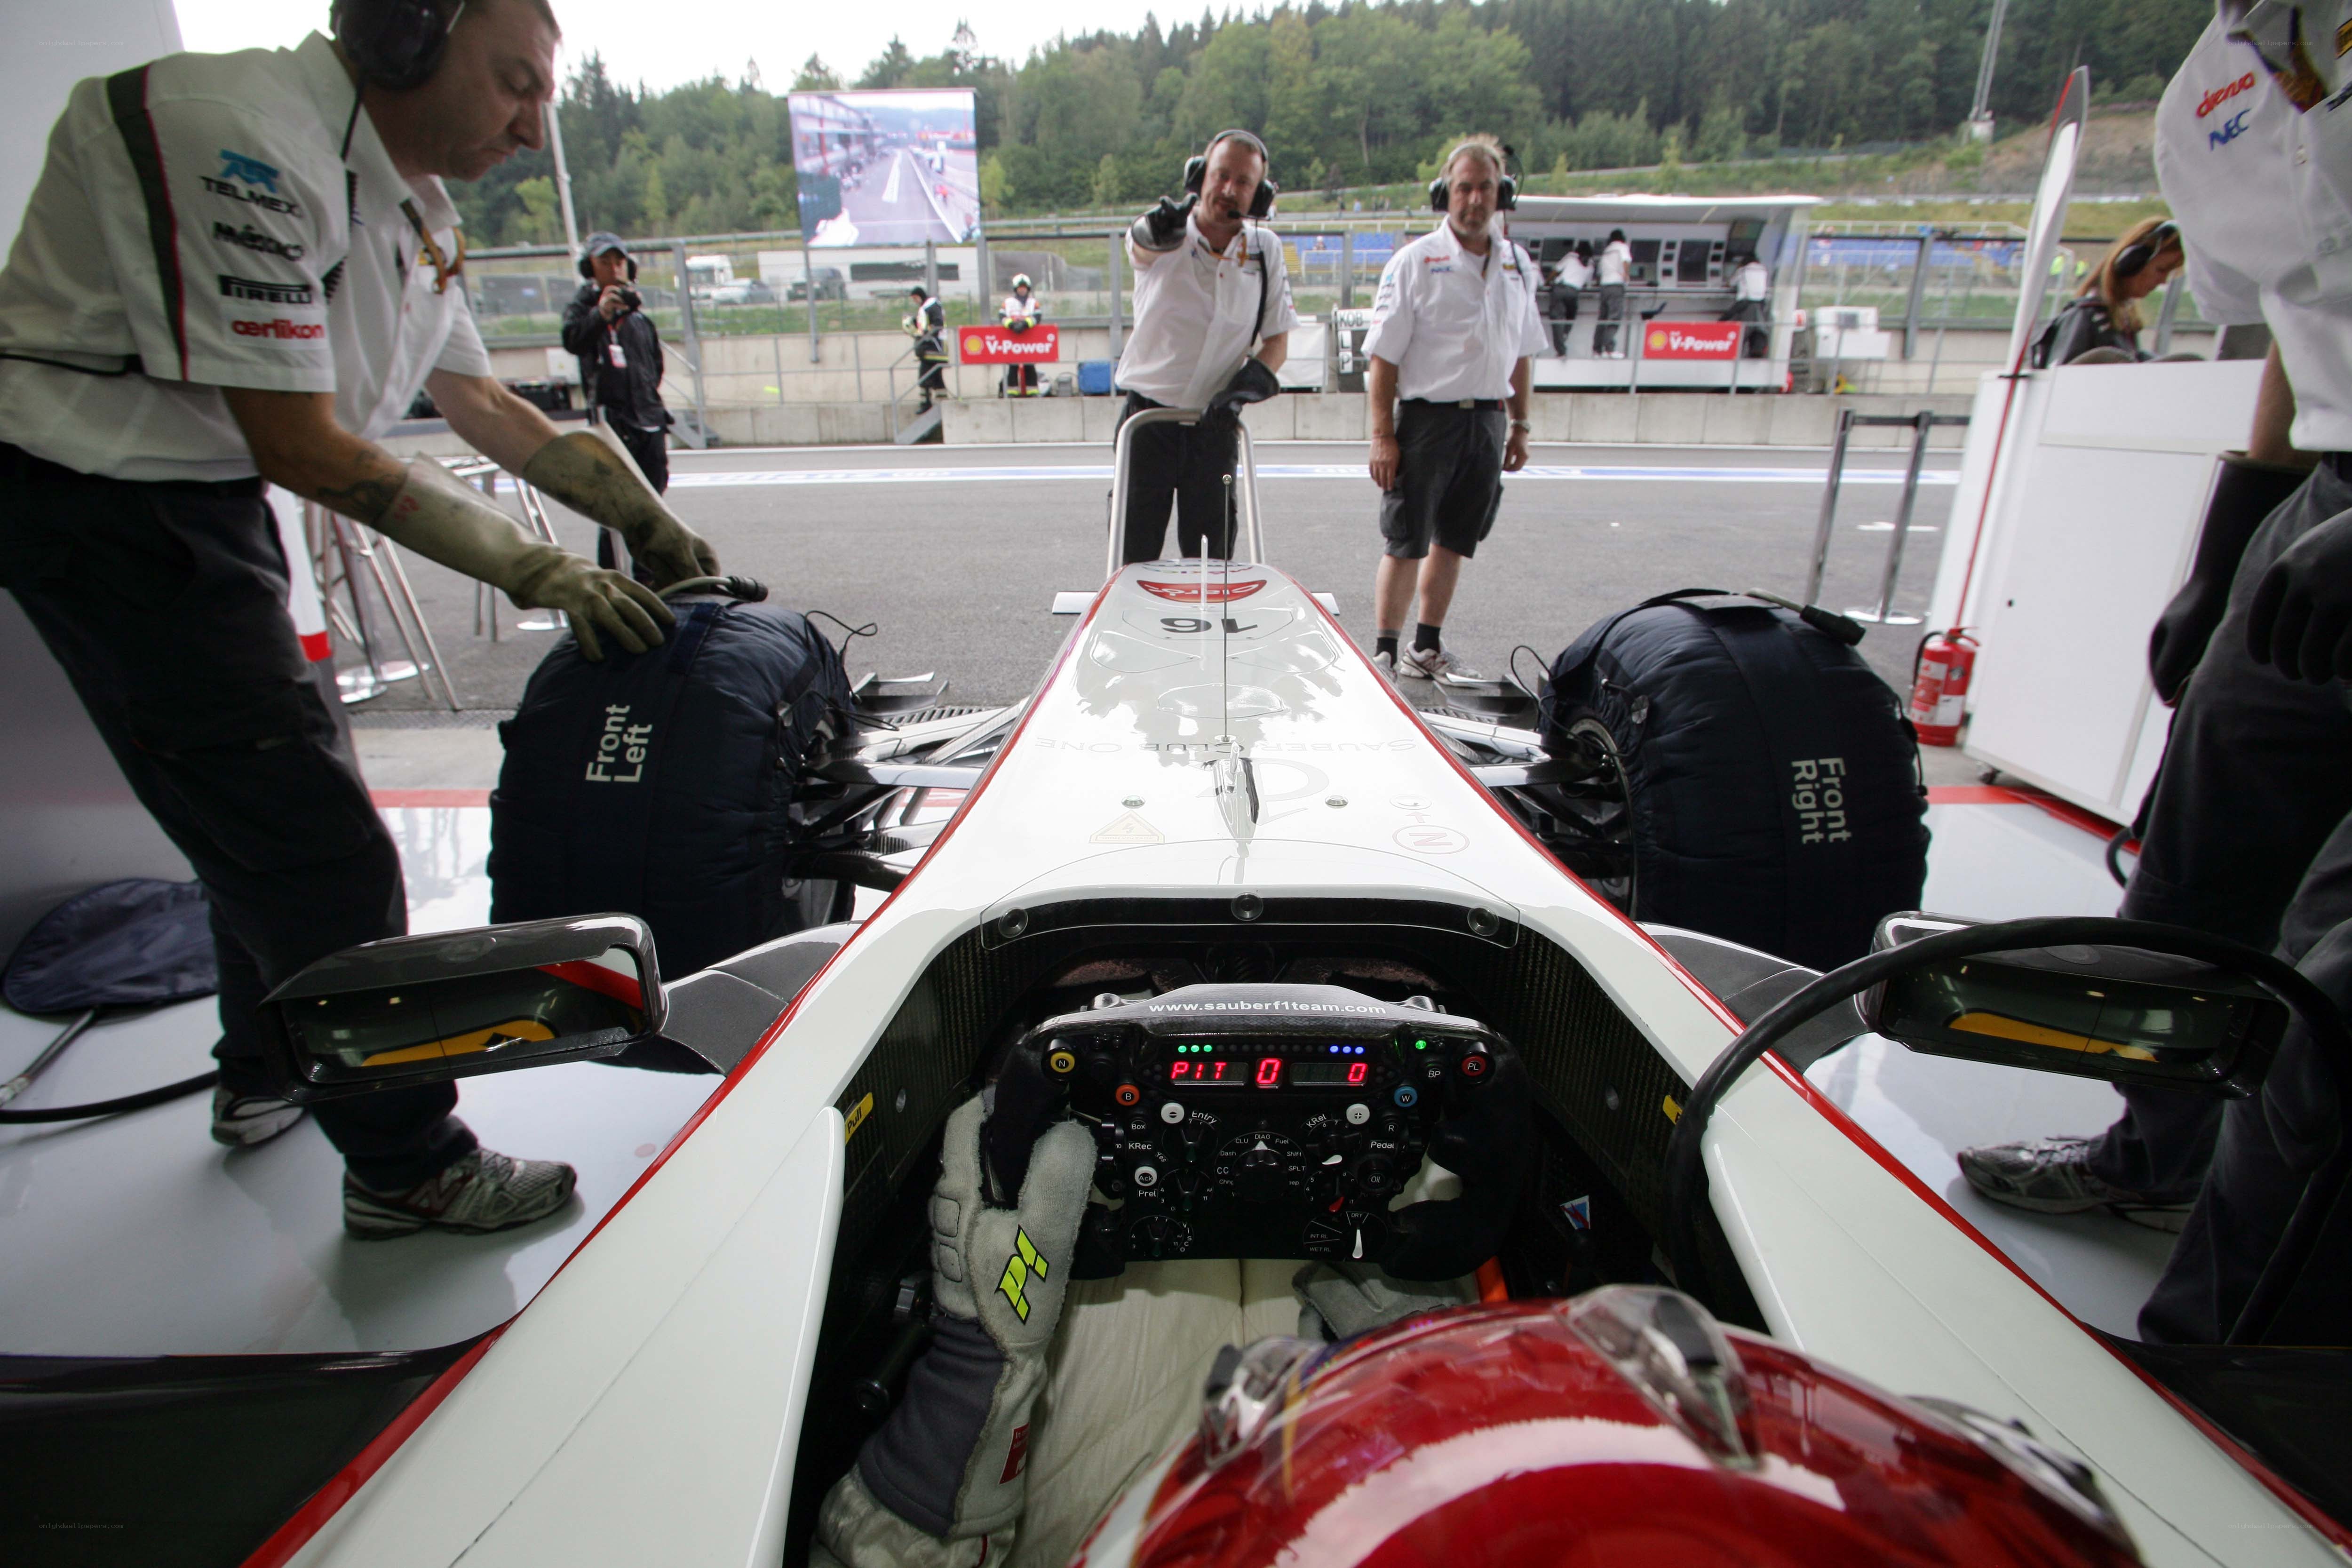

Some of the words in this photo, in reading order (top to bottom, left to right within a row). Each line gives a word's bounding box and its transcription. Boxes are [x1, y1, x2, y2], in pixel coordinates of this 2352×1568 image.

[2209, 108, 2251, 151] NEC
[200, 176, 303, 218] TELMEX
[218, 274, 313, 304] PIRELLI
[1340, 311, 1364, 327] KOB
[985, 340, 1054, 355] V-Power
[1669, 336, 1733, 351] V-Power
[1160, 618, 1258, 634] 16
[586, 703, 630, 782] Front
[1034, 737, 1123, 753] ONE
[613, 724, 653, 783] Left
[1791, 759, 1825, 845] Right
[1818, 757, 1852, 844] Front
[1149, 1000, 1387, 1014] www.sauberf1team.com
[1170, 1061, 1227, 1080] PIT
[1255, 1058, 1282, 1084] 0
[1347, 1062, 1368, 1082] 0
[1467, 1062, 1479, 1071] PL
[847, 1108, 862, 1134] Pull
[1192, 1110, 1218, 1125] Entry
[1306, 1114, 1327, 1128] KRel
